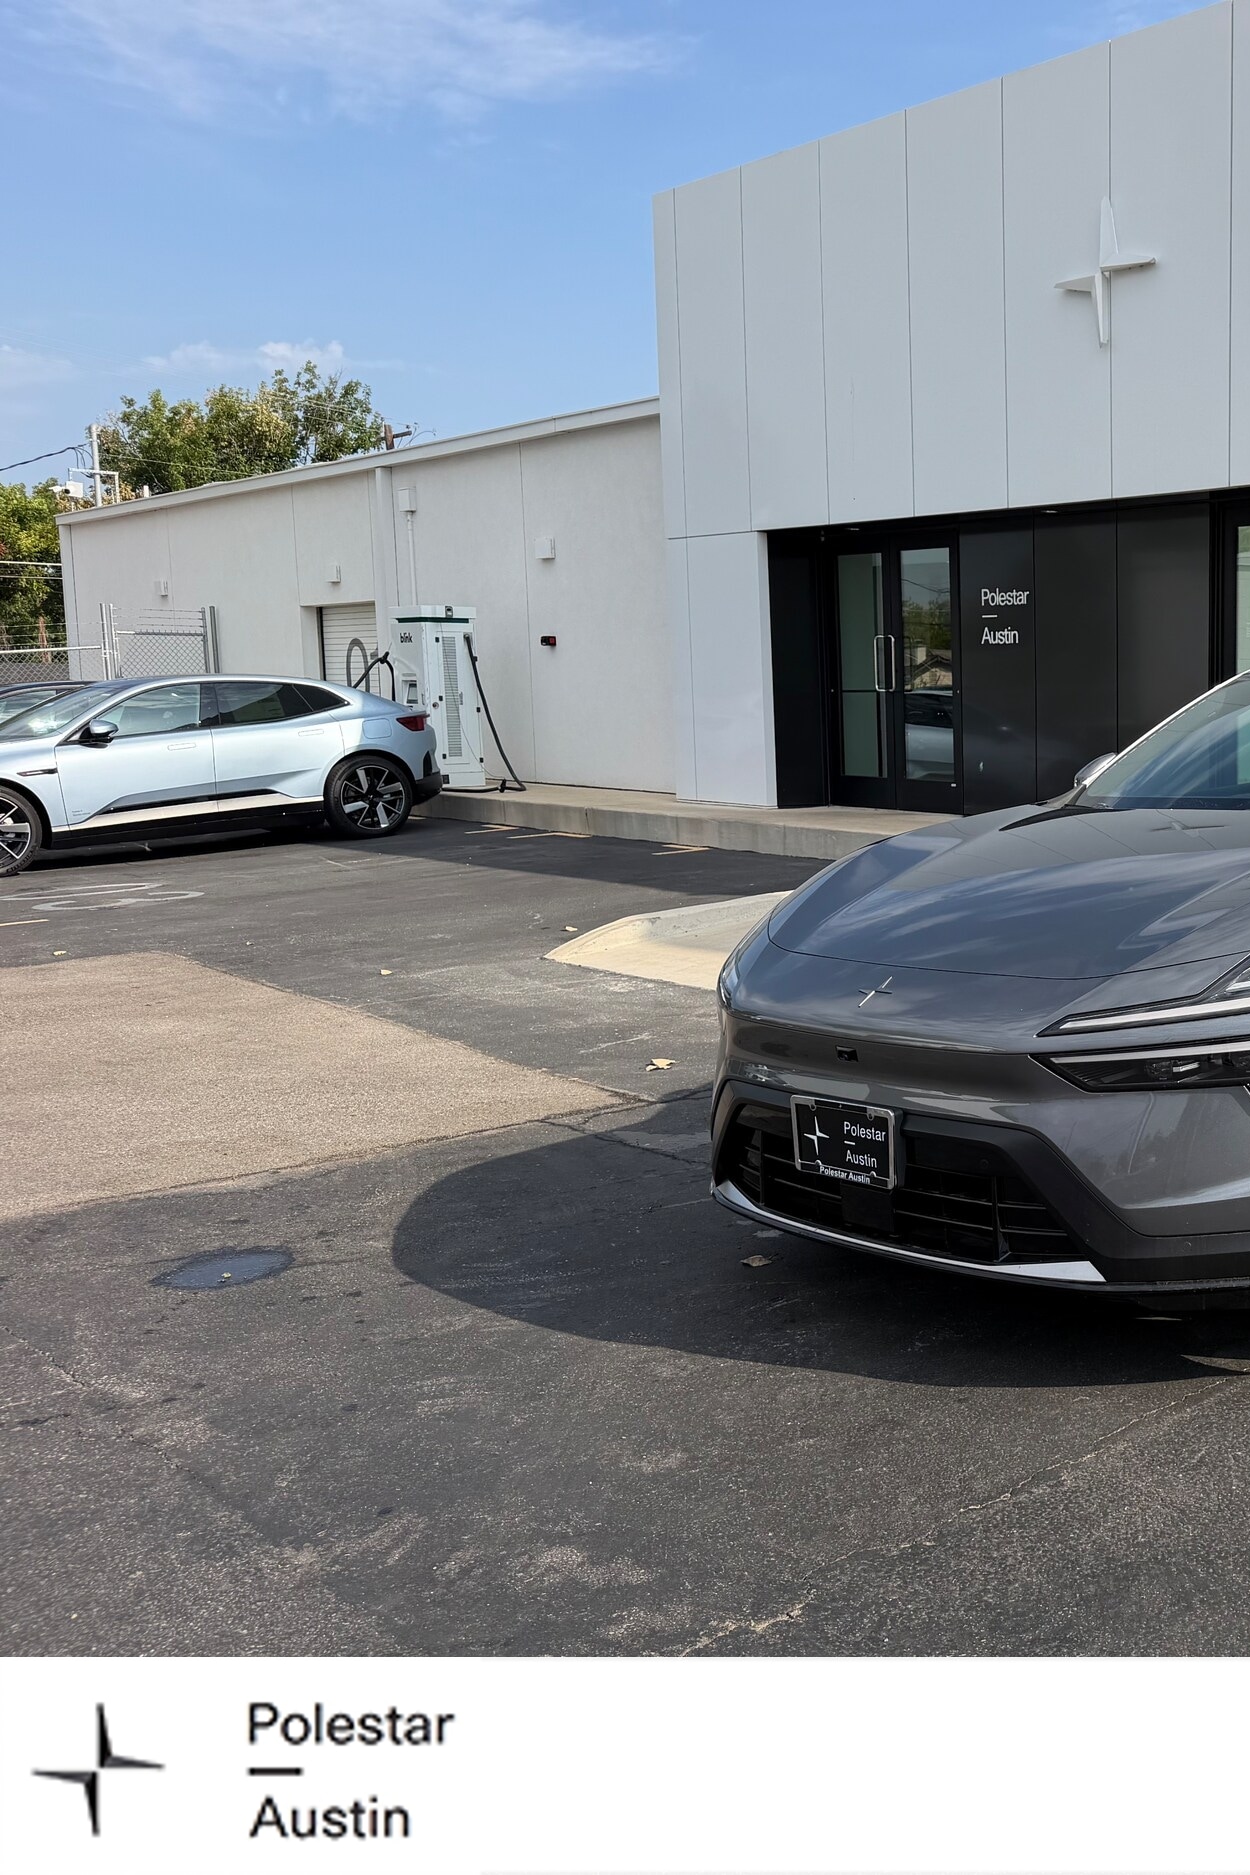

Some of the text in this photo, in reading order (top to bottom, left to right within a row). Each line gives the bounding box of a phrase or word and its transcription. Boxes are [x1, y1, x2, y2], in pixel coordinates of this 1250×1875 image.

[981, 587, 1030, 606] Polestar
[981, 626, 1019, 644] Austin
[843, 1121, 886, 1142] Polestar
[846, 1149, 877, 1168] Austin
[819, 1165, 871, 1184] Polestar Austin
